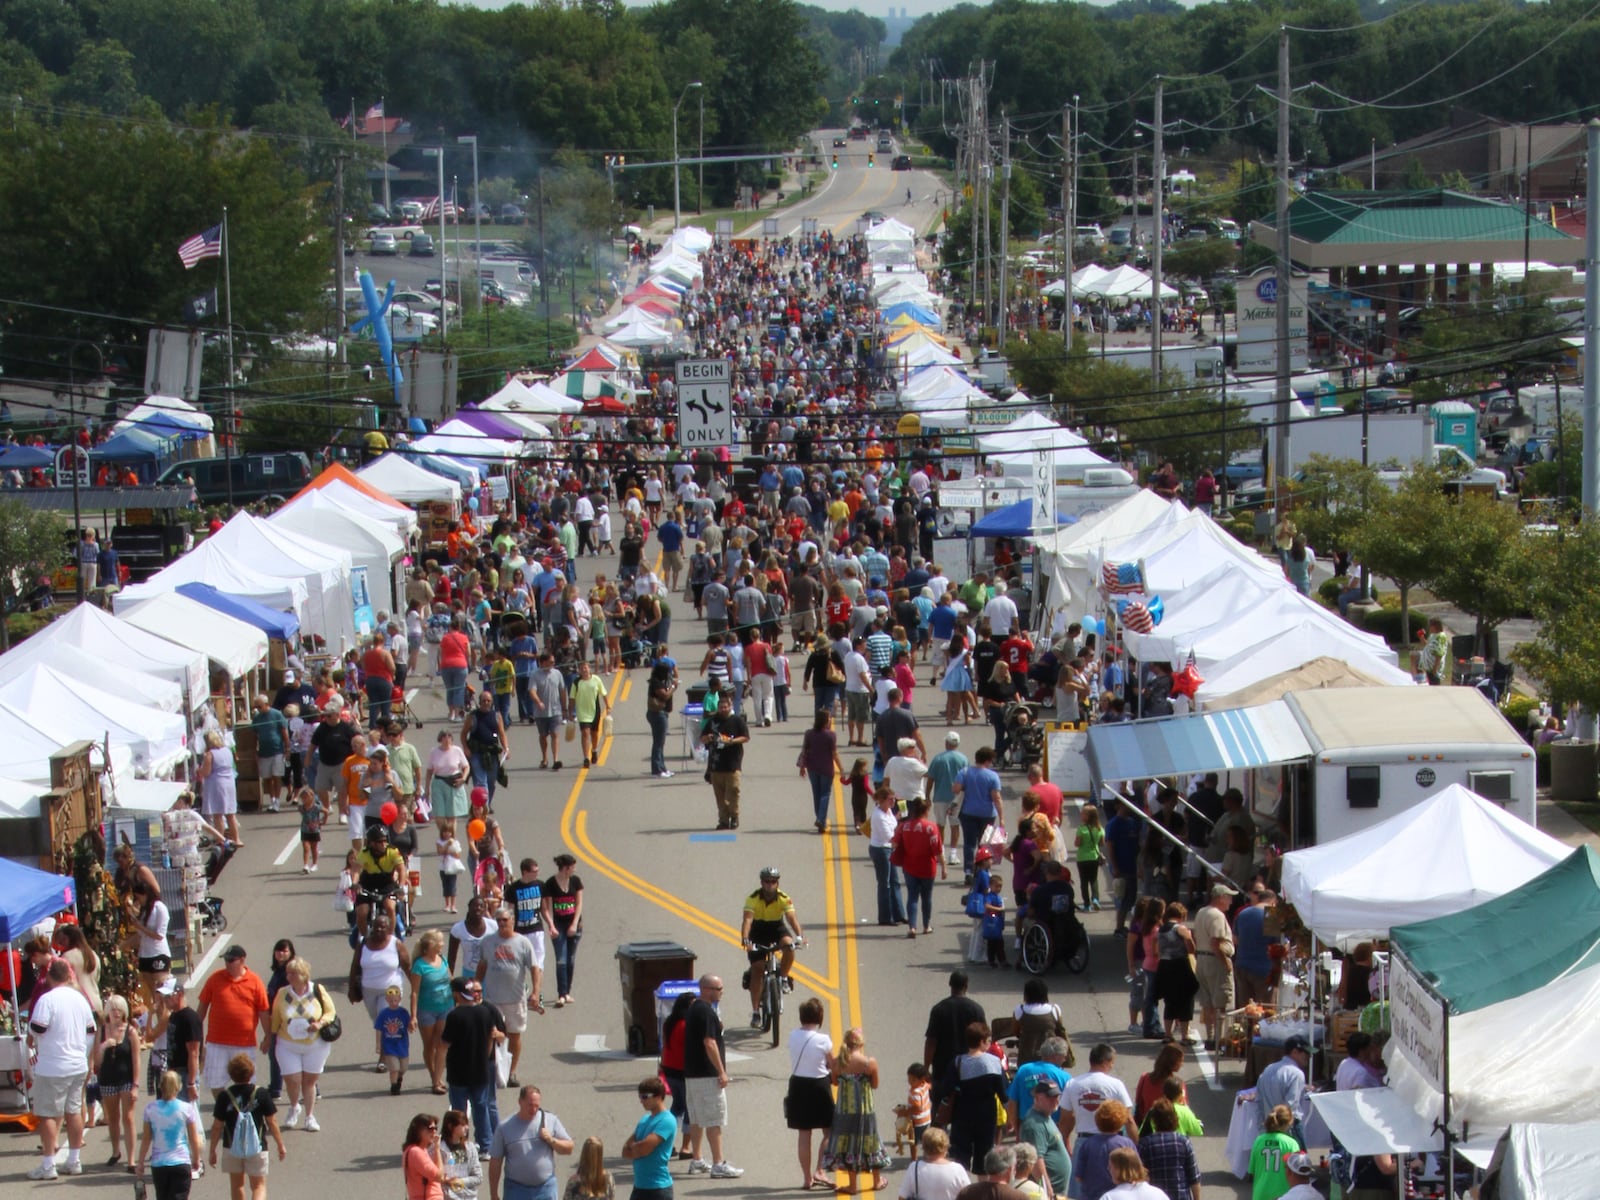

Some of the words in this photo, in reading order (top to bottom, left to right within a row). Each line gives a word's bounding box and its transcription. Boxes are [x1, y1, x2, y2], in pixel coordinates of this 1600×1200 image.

[683, 364, 723, 378] BEGIN
[687, 428, 725, 442] ONLY
[1010, 647, 1019, 664] 2
[1261, 1147, 1281, 1172] 11
